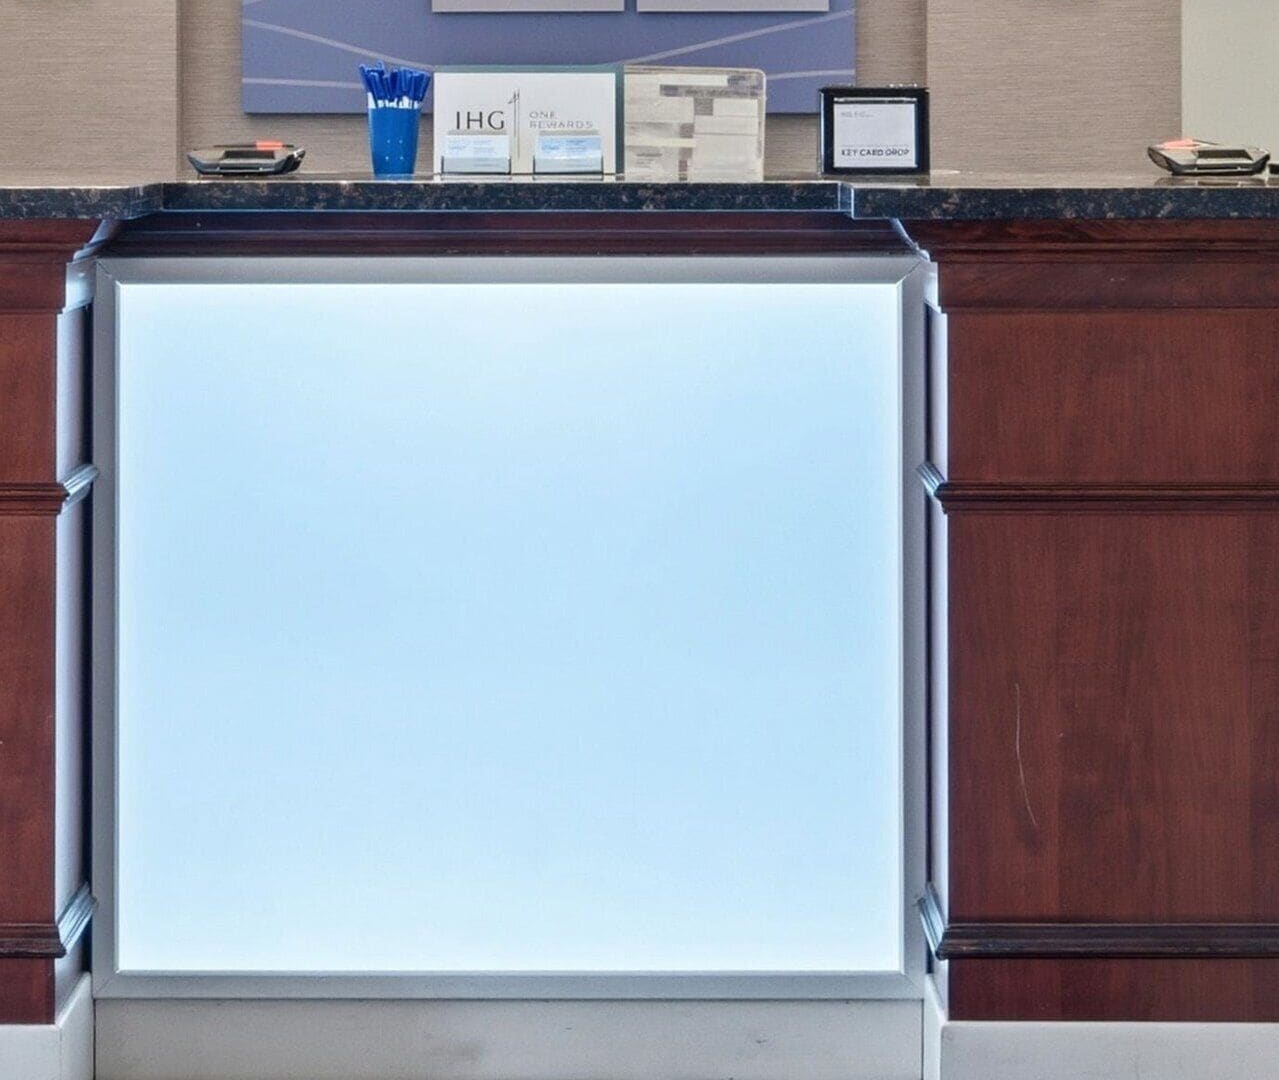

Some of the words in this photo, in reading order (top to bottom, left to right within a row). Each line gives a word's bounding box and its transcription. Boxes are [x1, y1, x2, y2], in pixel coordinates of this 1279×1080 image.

[529, 111, 556, 120] ONE
[456, 110, 505, 130] IHG
[529, 121, 593, 129] REWARDS
[860, 148, 884, 156] CARD
